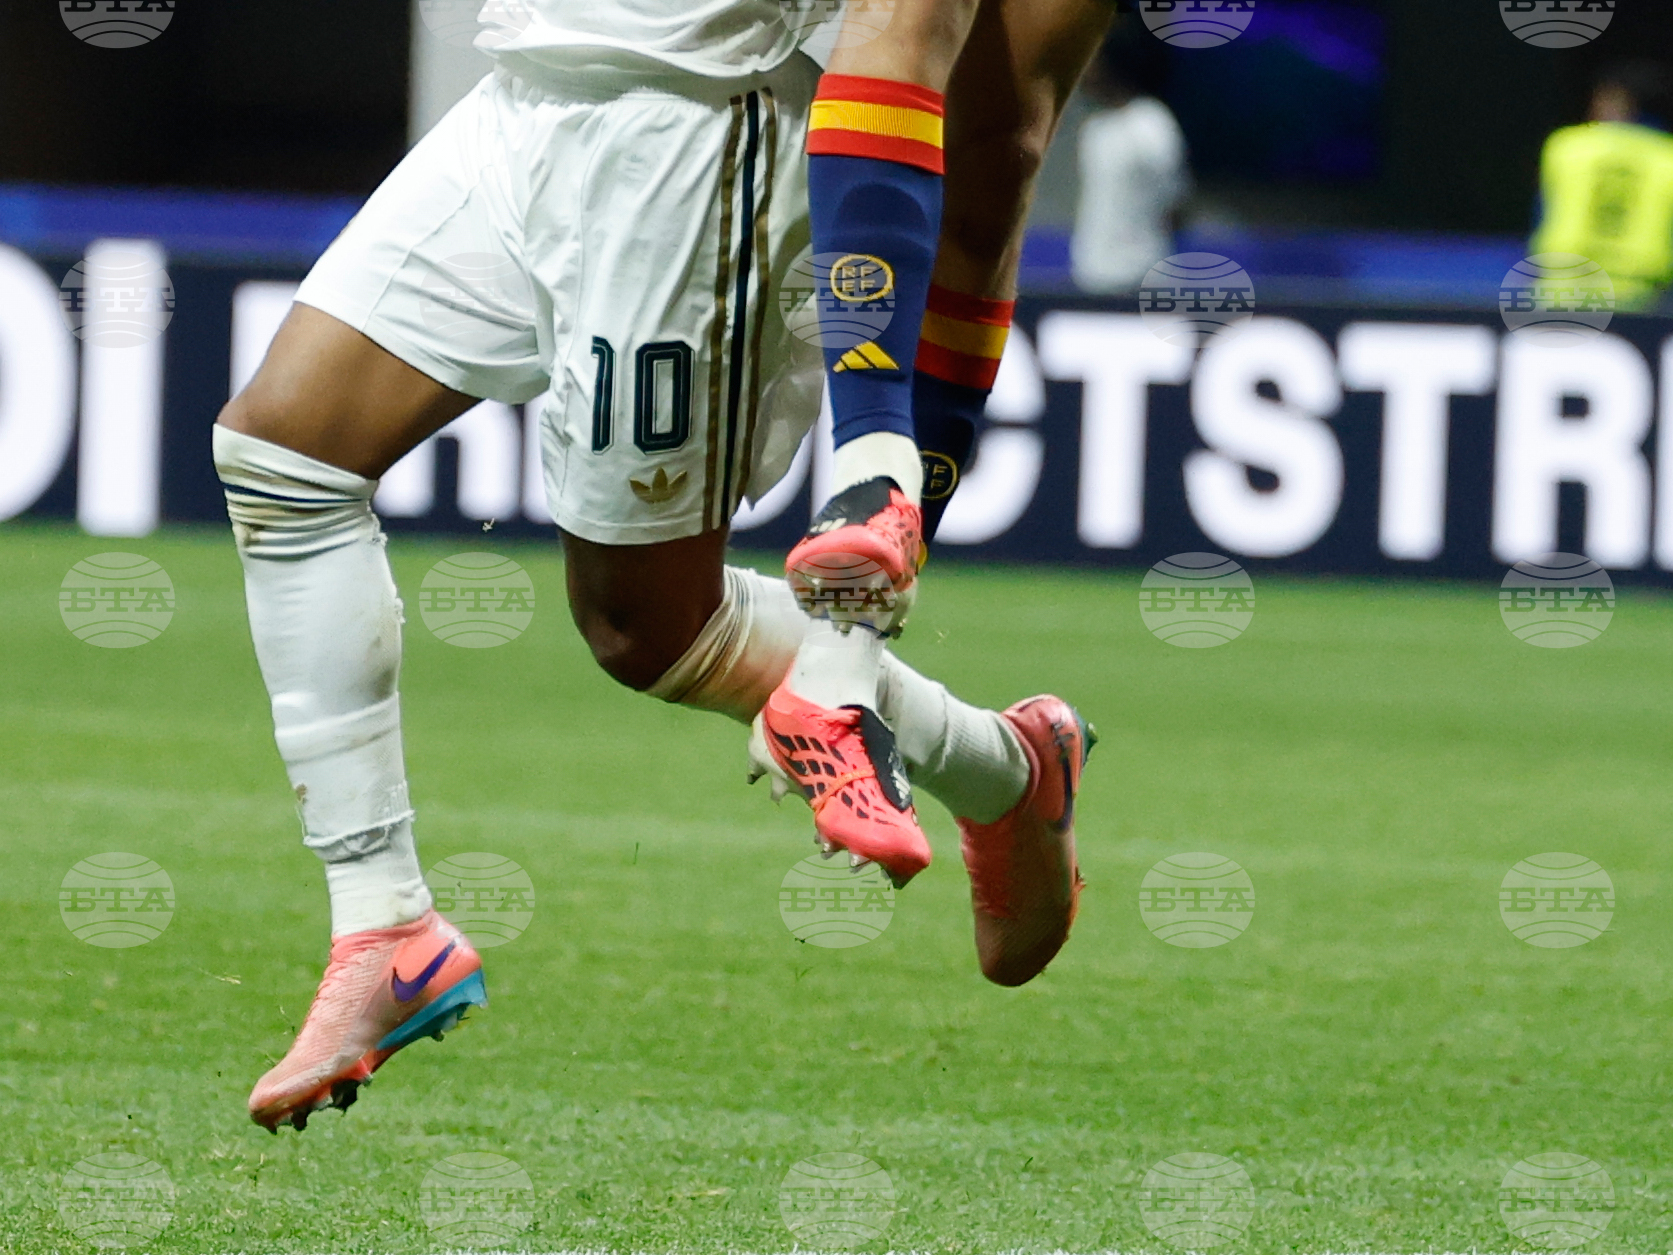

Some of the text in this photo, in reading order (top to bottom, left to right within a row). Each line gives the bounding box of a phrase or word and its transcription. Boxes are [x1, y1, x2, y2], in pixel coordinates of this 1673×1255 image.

[841, 265, 878, 279] RF
[841, 279, 877, 293] EF
[590, 334, 696, 456] 10
